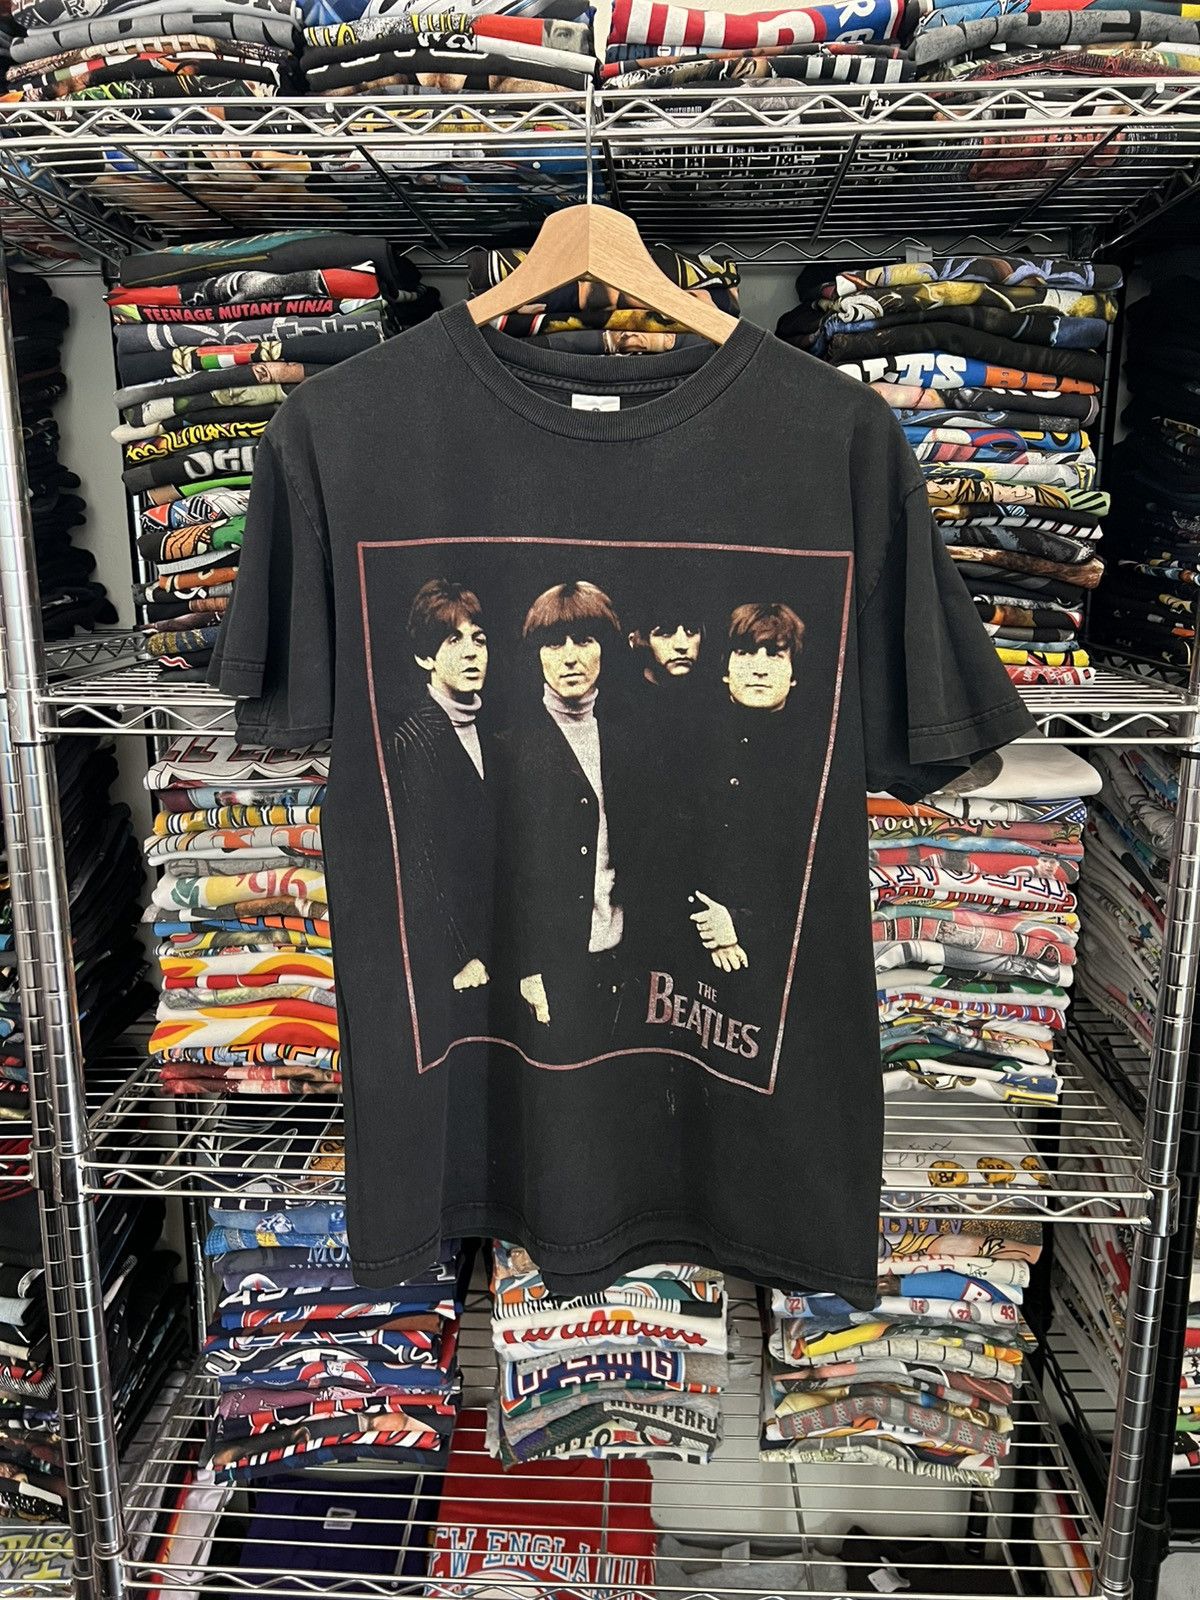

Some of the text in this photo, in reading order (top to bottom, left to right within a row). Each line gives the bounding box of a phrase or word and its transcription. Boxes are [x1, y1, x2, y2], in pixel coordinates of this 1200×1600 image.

[143, 299, 334, 322] TEENAGE MUTANT NINJA
[697, 981, 718, 1003] THE
[645, 970, 762, 1059] BEATLES
